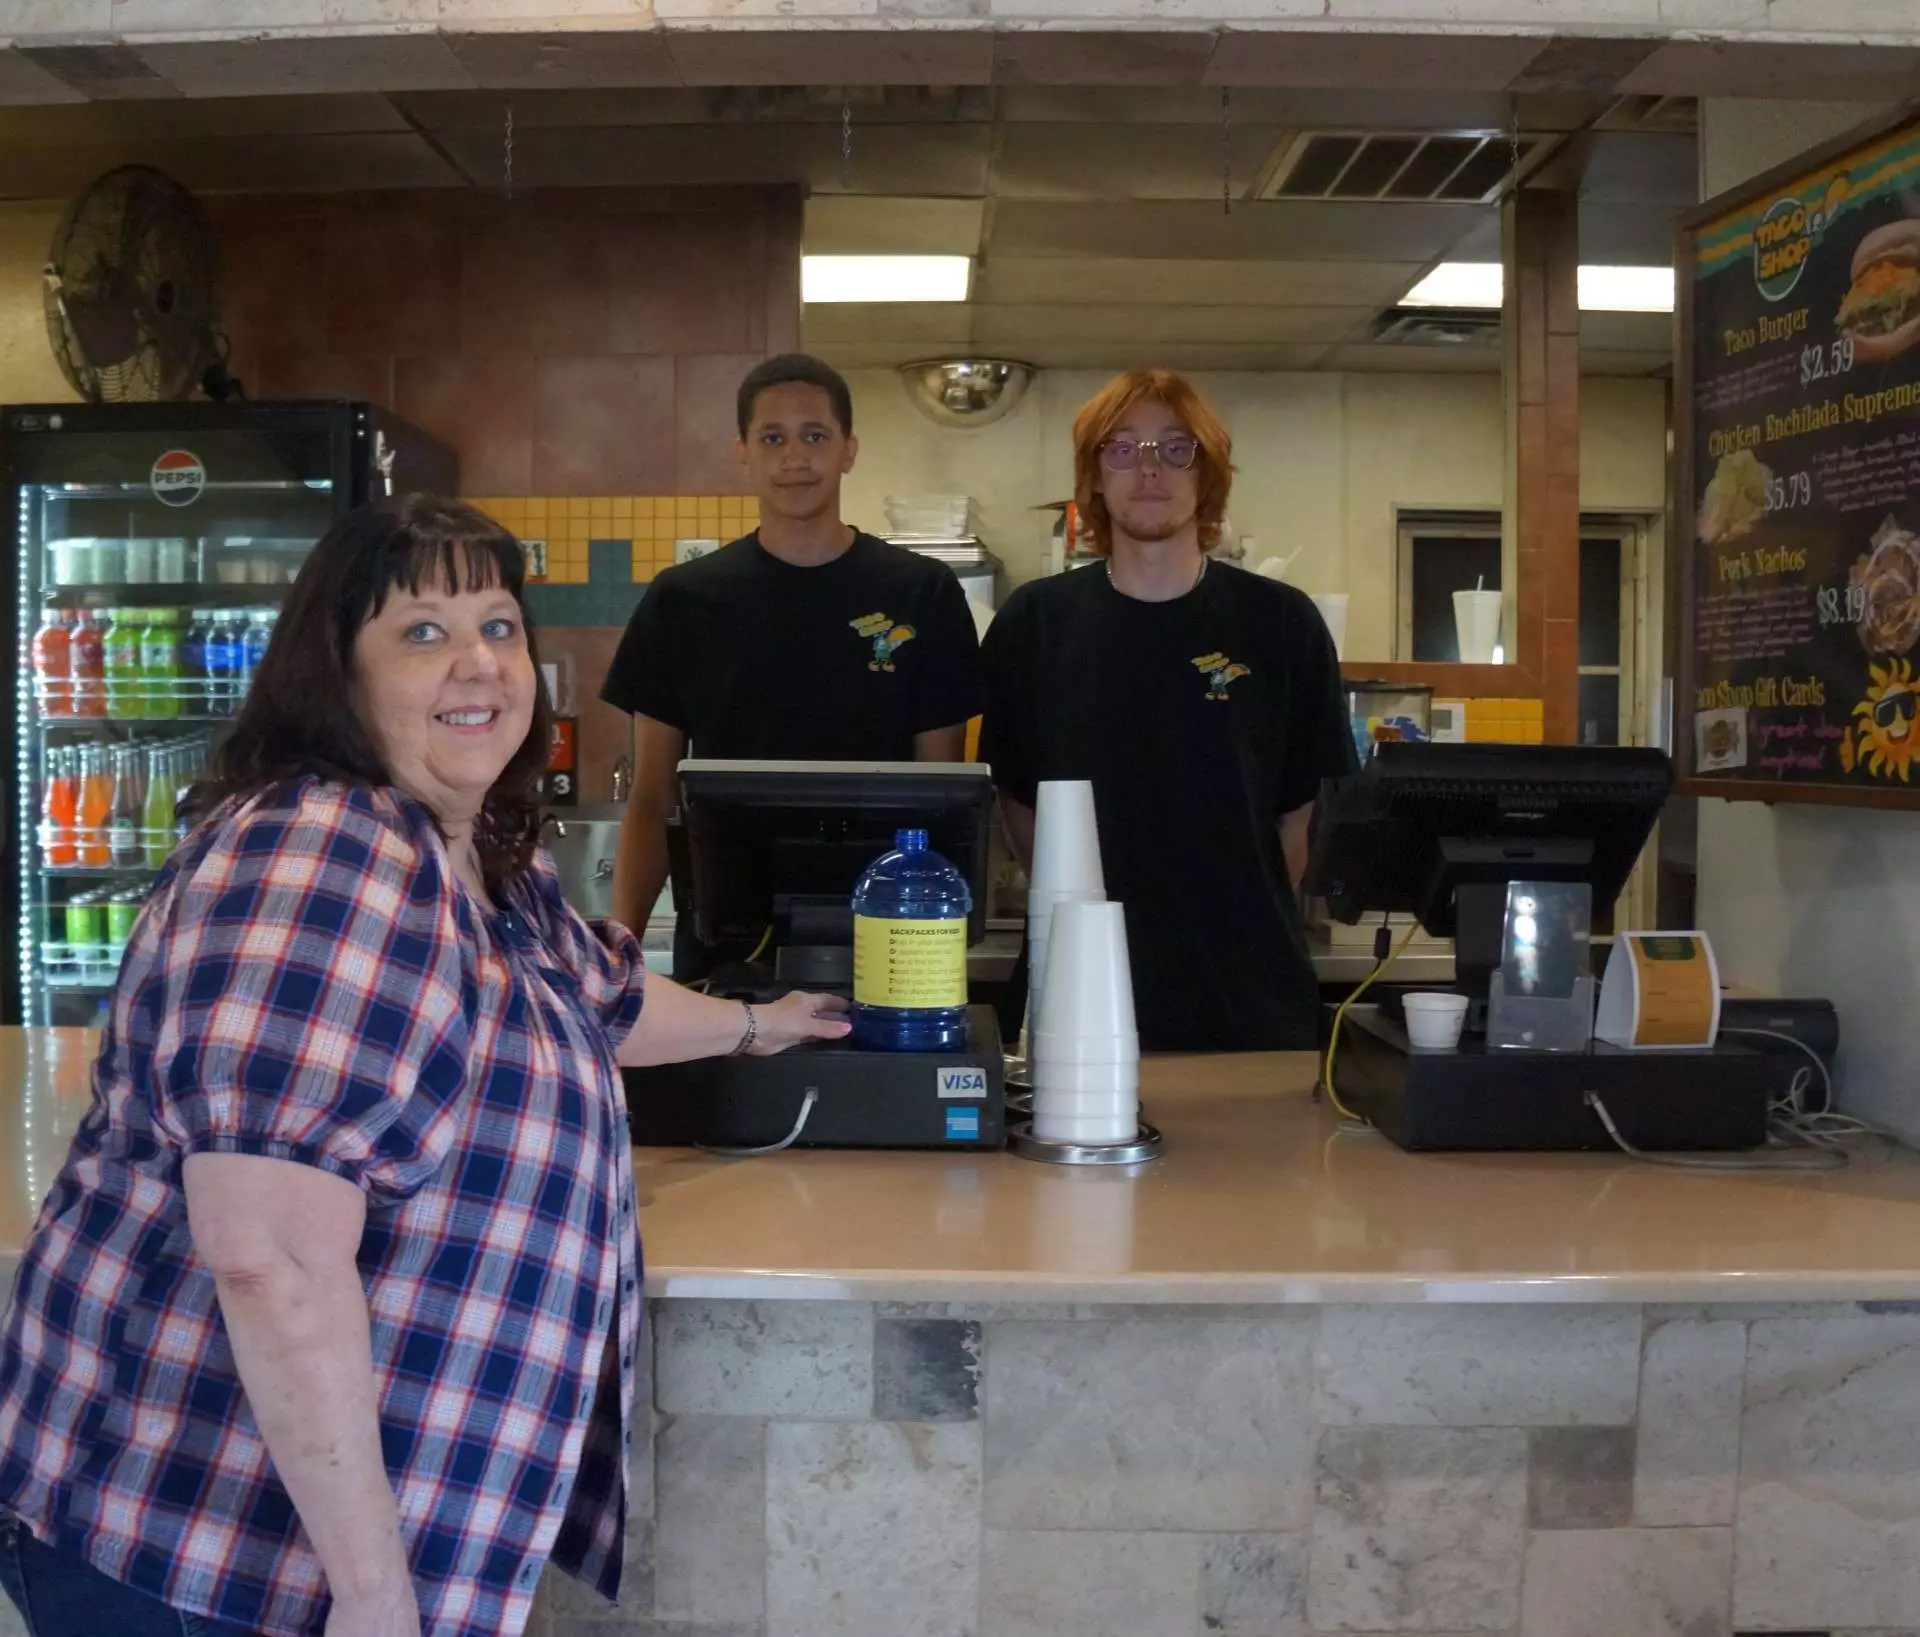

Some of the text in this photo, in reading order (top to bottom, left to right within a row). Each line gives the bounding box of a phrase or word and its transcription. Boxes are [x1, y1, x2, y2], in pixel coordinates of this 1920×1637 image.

[1754, 206, 1806, 248] TACO
[1759, 236, 1812, 281] SHOP
[1724, 308, 1809, 357] Taco Burger
[1800, 336, 1855, 391] $2.59
[1708, 423, 1761, 458] Chicken
[1766, 400, 1839, 442] Enchilada
[1844, 381, 1920, 423] Supreme
[1764, 471, 1811, 512] $5.79
[1718, 545, 1807, 580] Pork Nachos
[1817, 586, 1866, 629] $8.19
[1755, 677, 1777, 707] Gift
[1781, 676, 1827, 707] Cards
[890, 928, 935, 936] BACKPACKS
[936, 928, 948, 936] FOR
[943, 1074, 984, 1090] VISA
